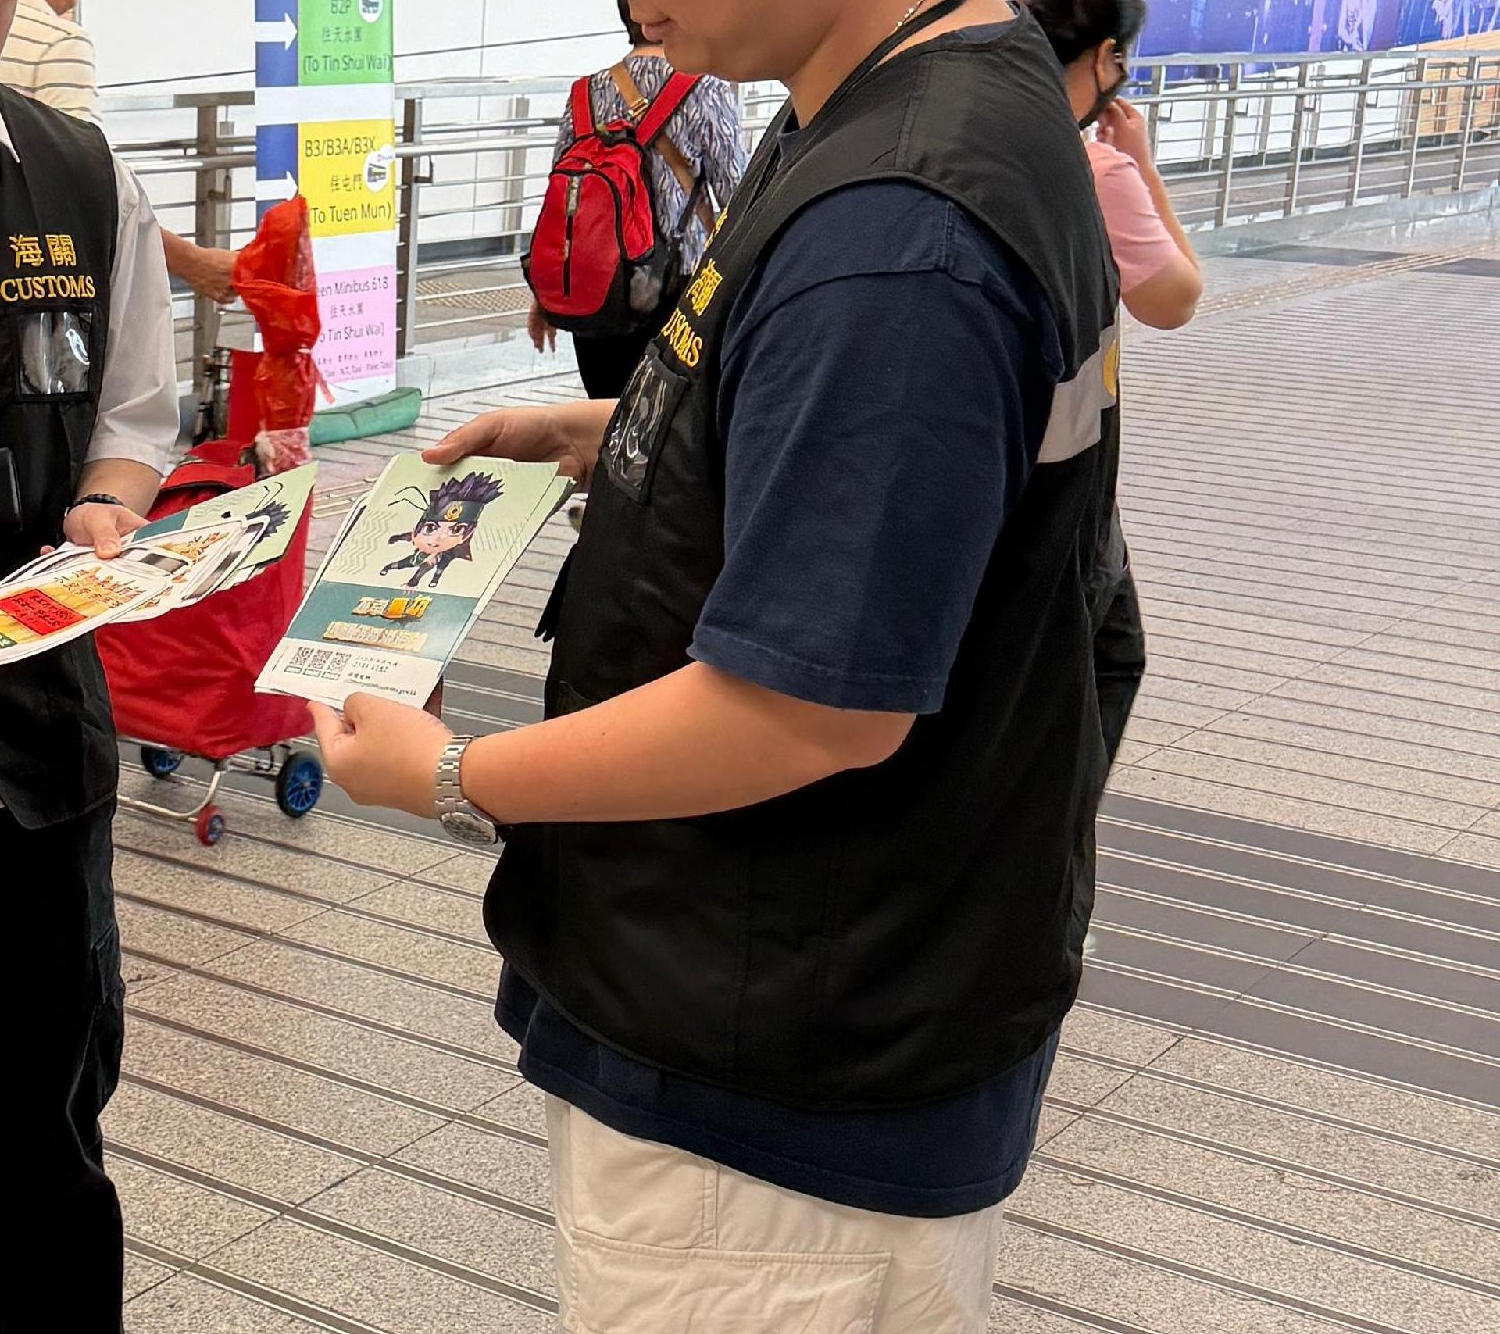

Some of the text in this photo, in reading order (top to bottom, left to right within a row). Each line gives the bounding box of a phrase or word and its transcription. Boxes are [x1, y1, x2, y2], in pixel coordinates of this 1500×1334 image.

[322, 54, 341, 73] Tin
[329, 204, 357, 223] Tuen
[361, 201, 392, 221] Mun)
[10, 233, 78, 269] 海關
[0, 275, 96, 303] CUSTOMS
